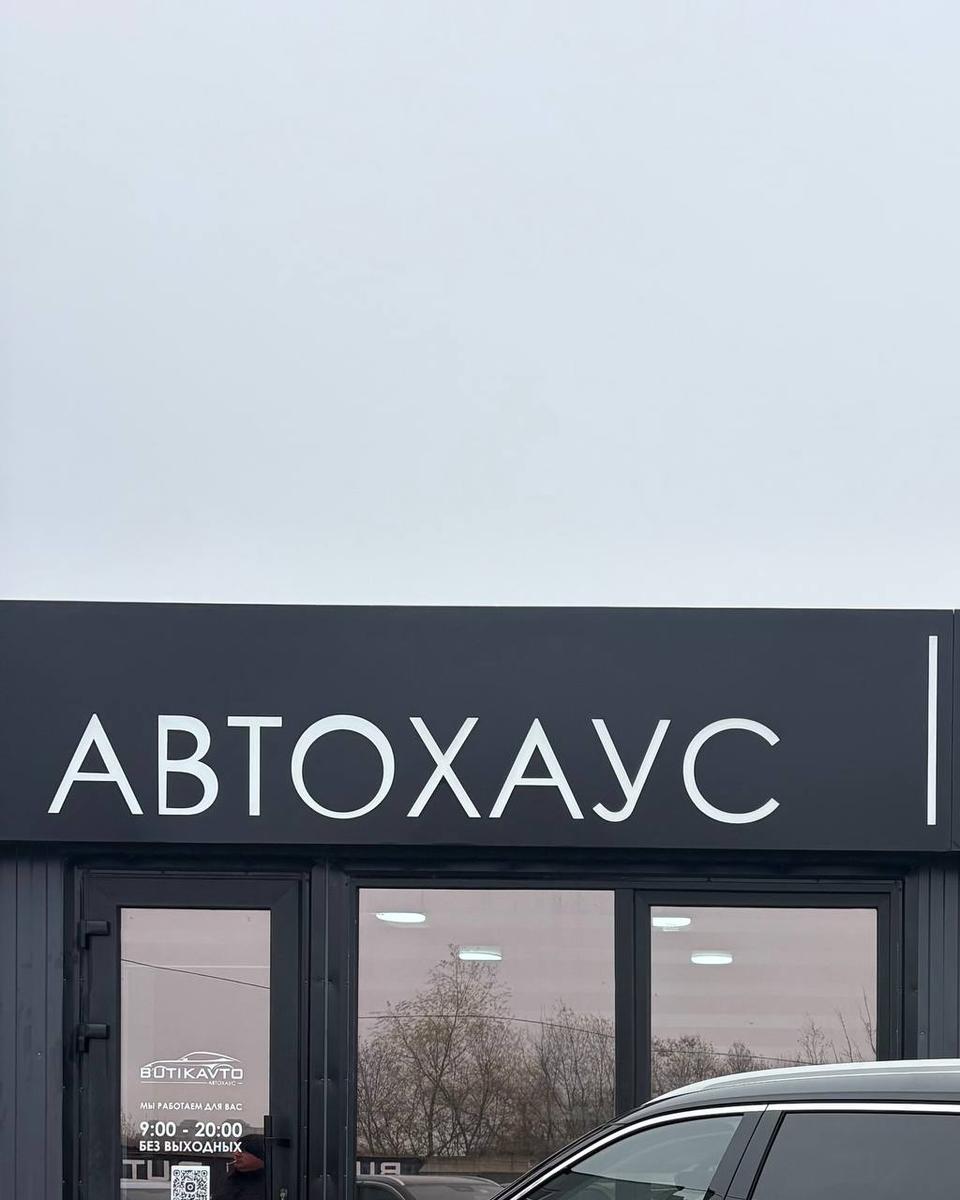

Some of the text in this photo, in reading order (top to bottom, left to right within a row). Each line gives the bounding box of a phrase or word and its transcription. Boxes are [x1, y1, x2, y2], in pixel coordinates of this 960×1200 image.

[47, 713, 781, 825] АВТОХАУС
[140, 1067, 243, 1079] BUTIKAVTO
[140, 1102, 243, 1111] МЫ РАБОТАЕМ ДЛЯ ВАС
[140, 1121, 177, 1137] 9:00
[194, 1121, 243, 1138] 20:00
[139, 1140, 242, 1154] БЕЗ ВЫХОДНЫХ
